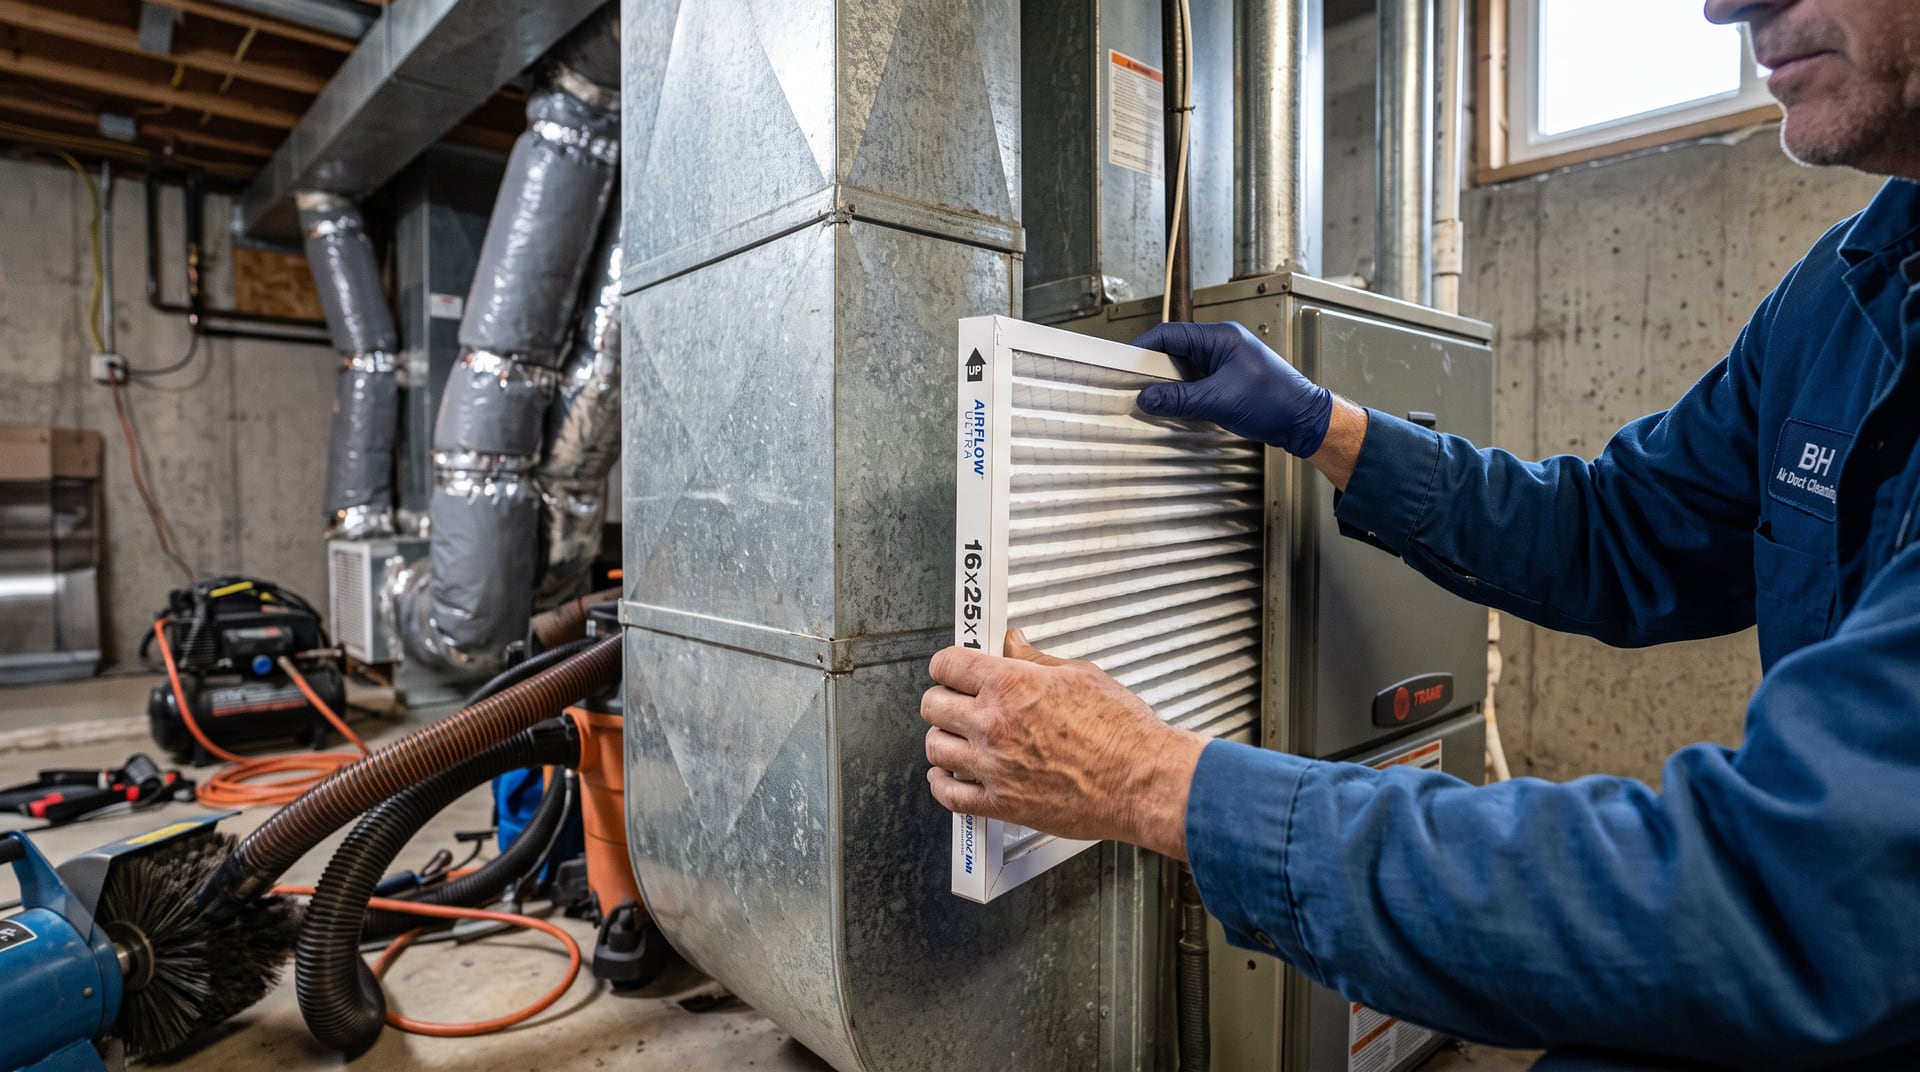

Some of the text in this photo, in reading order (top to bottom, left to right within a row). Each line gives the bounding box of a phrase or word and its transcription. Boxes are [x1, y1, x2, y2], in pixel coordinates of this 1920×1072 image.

[968, 365, 982, 376] UP
[964, 411, 973, 459] ULTRA
[974, 399, 985, 476] AIRFLOW
[1797, 442, 1836, 477] BH
[1787, 472, 1807, 489] Duct
[963, 539, 983, 650] 16x25x1
